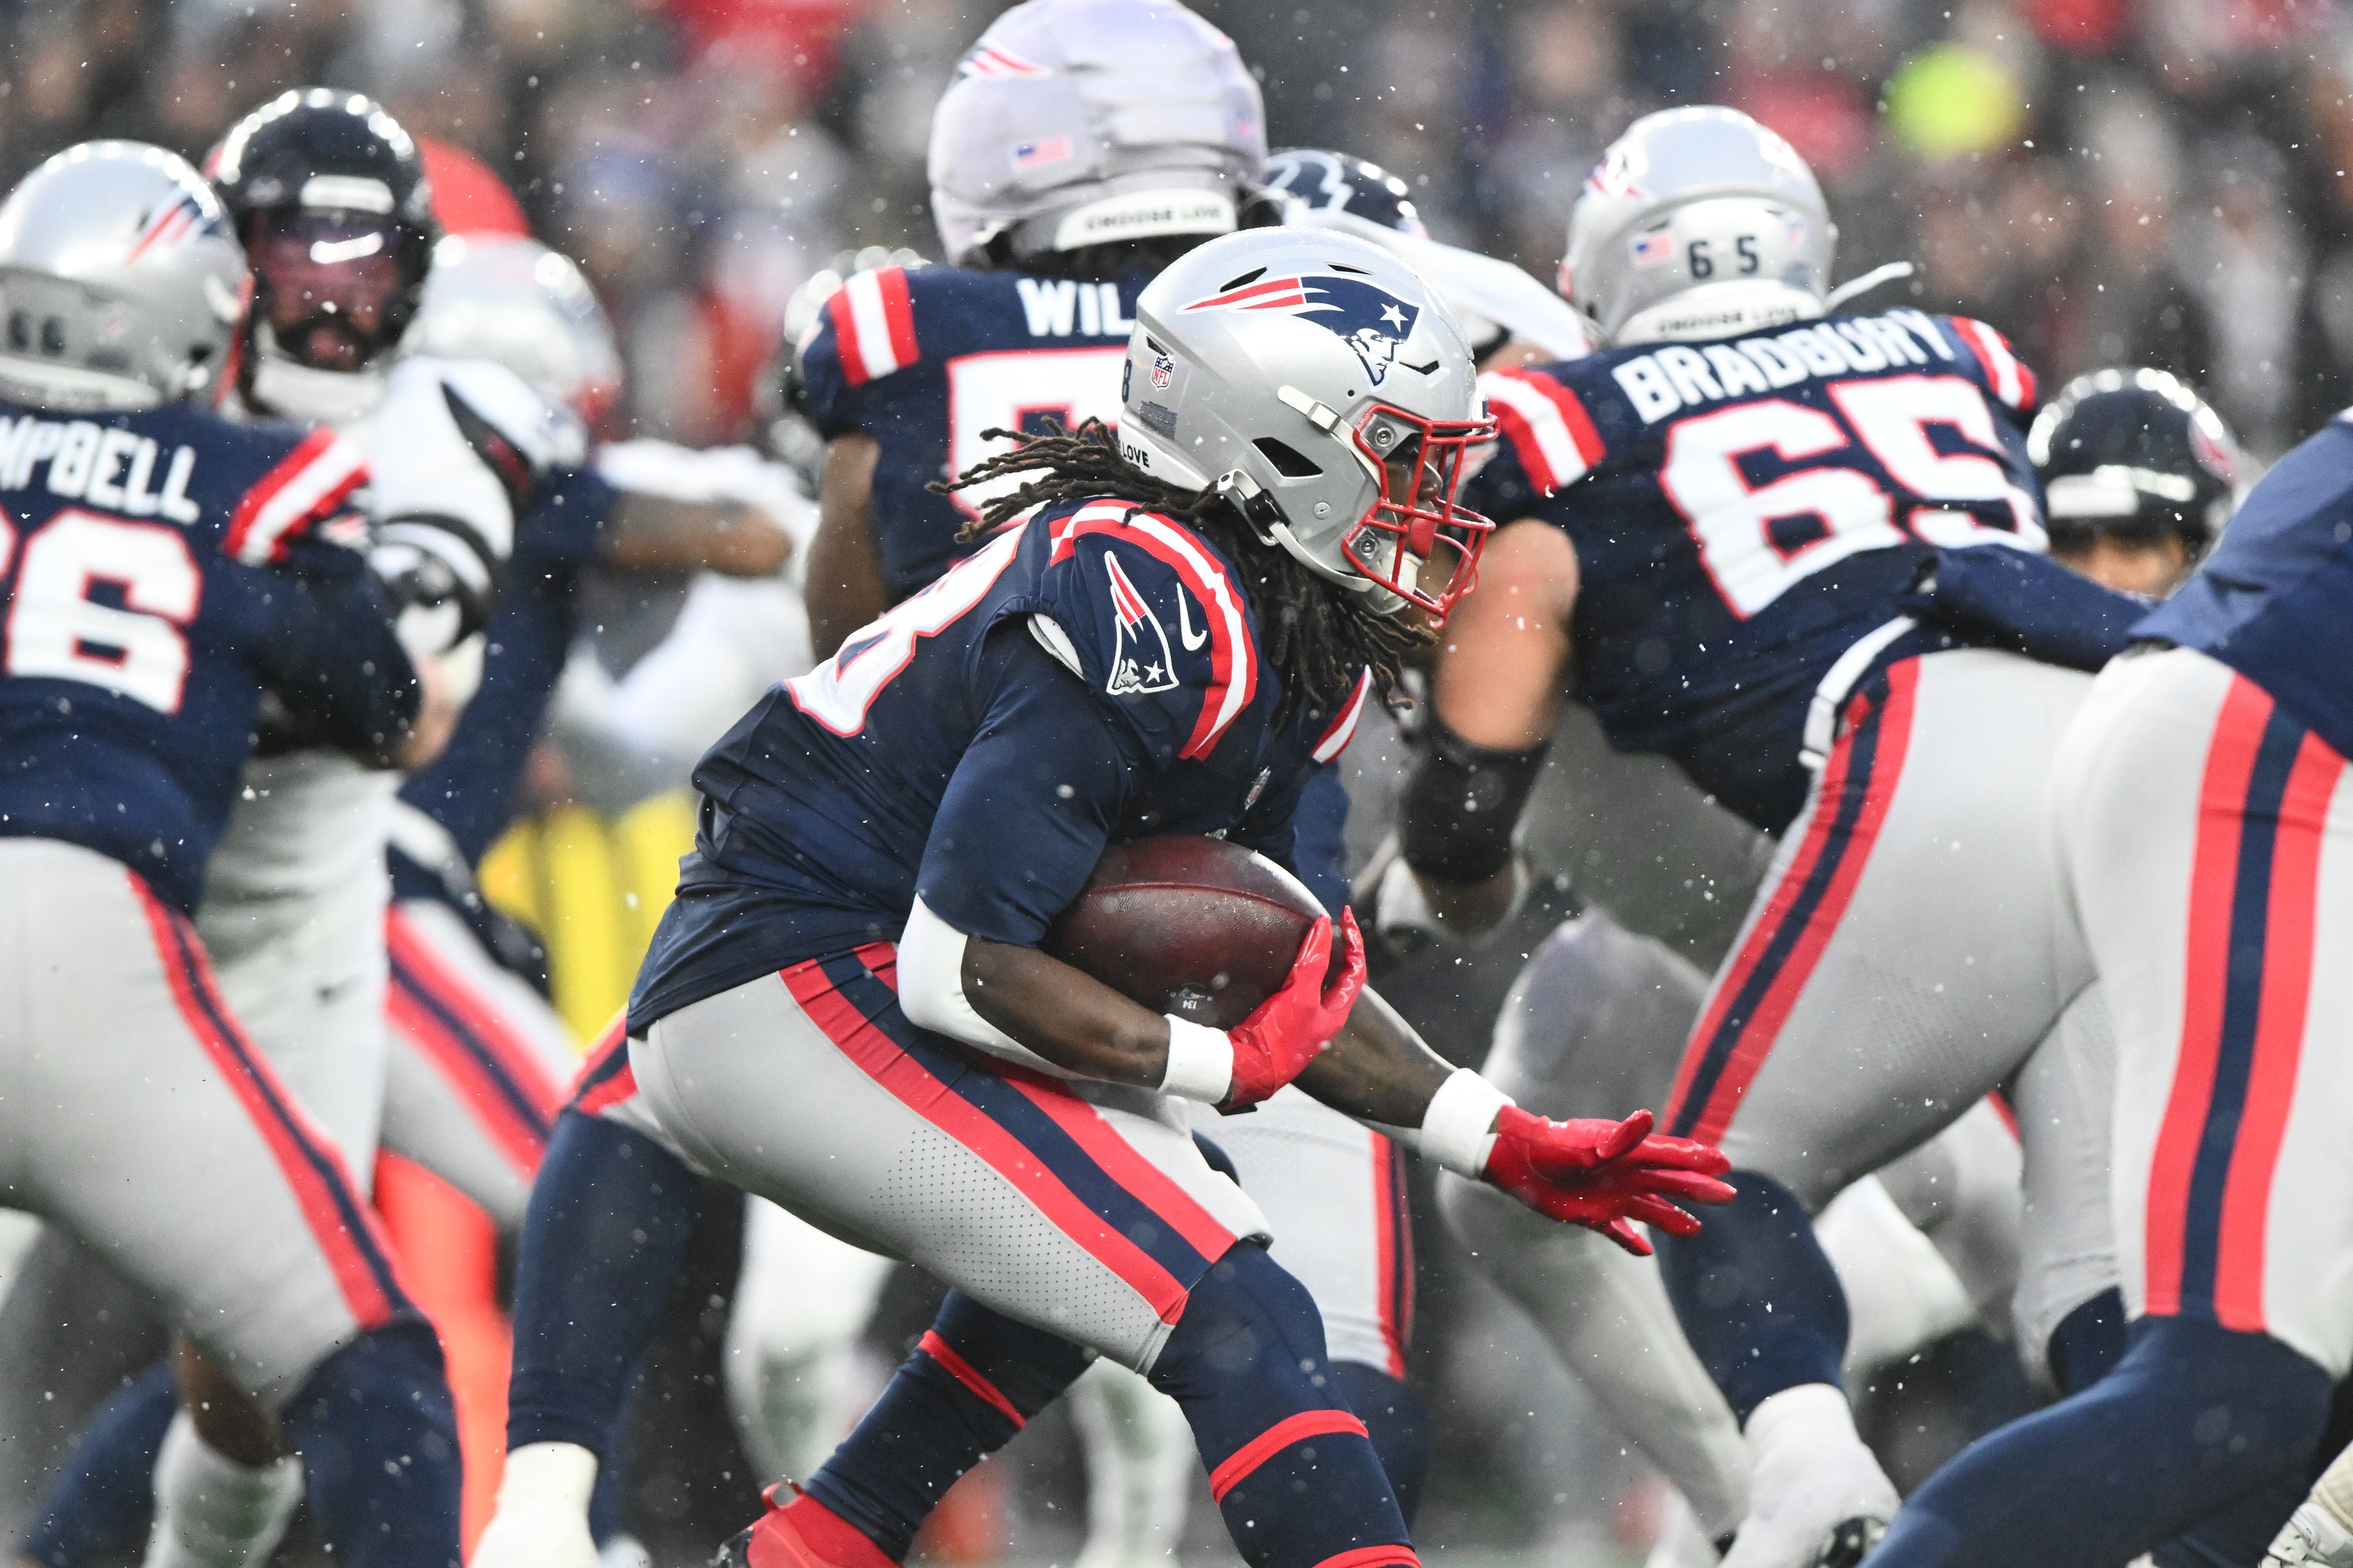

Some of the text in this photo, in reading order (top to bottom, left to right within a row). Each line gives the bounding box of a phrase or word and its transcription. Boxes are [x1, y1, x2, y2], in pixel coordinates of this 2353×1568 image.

[1689, 235, 1760, 280] 65
[1152, 367, 1171, 386] NFL
[1613, 308, 1956, 424] BRADBURY
[1122, 442, 1150, 468] LOVE
[1657, 373, 2050, 621] 65
[0, 504, 205, 716] 6
